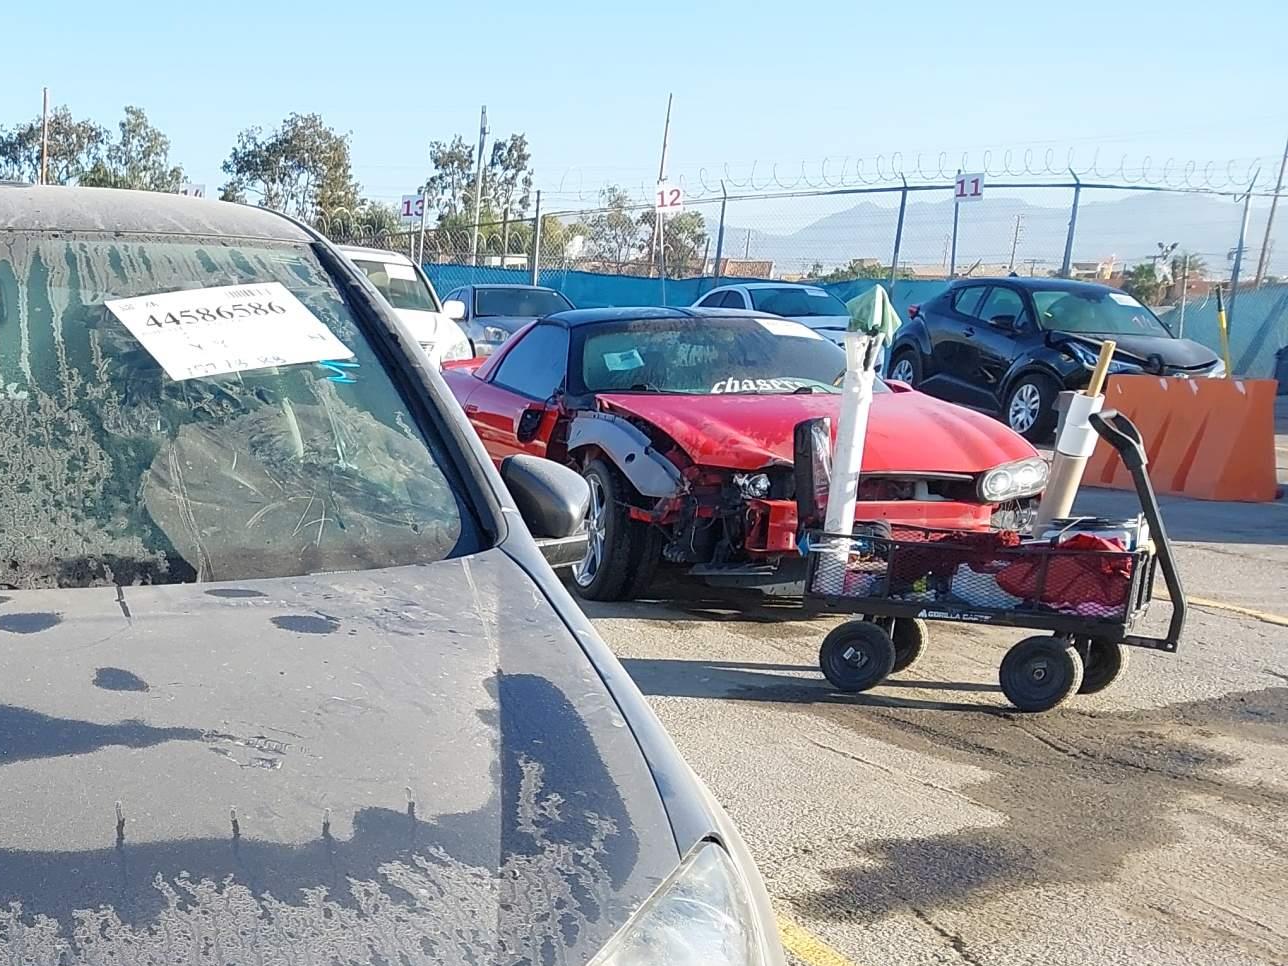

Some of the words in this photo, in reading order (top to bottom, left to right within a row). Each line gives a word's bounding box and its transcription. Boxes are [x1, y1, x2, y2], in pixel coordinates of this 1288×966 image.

[955, 178, 982, 197] 11
[656, 188, 681, 207] 12
[402, 199, 424, 216] 13
[144, 301, 287, 328] 44586586
[927, 610, 961, 619] GORILLA
